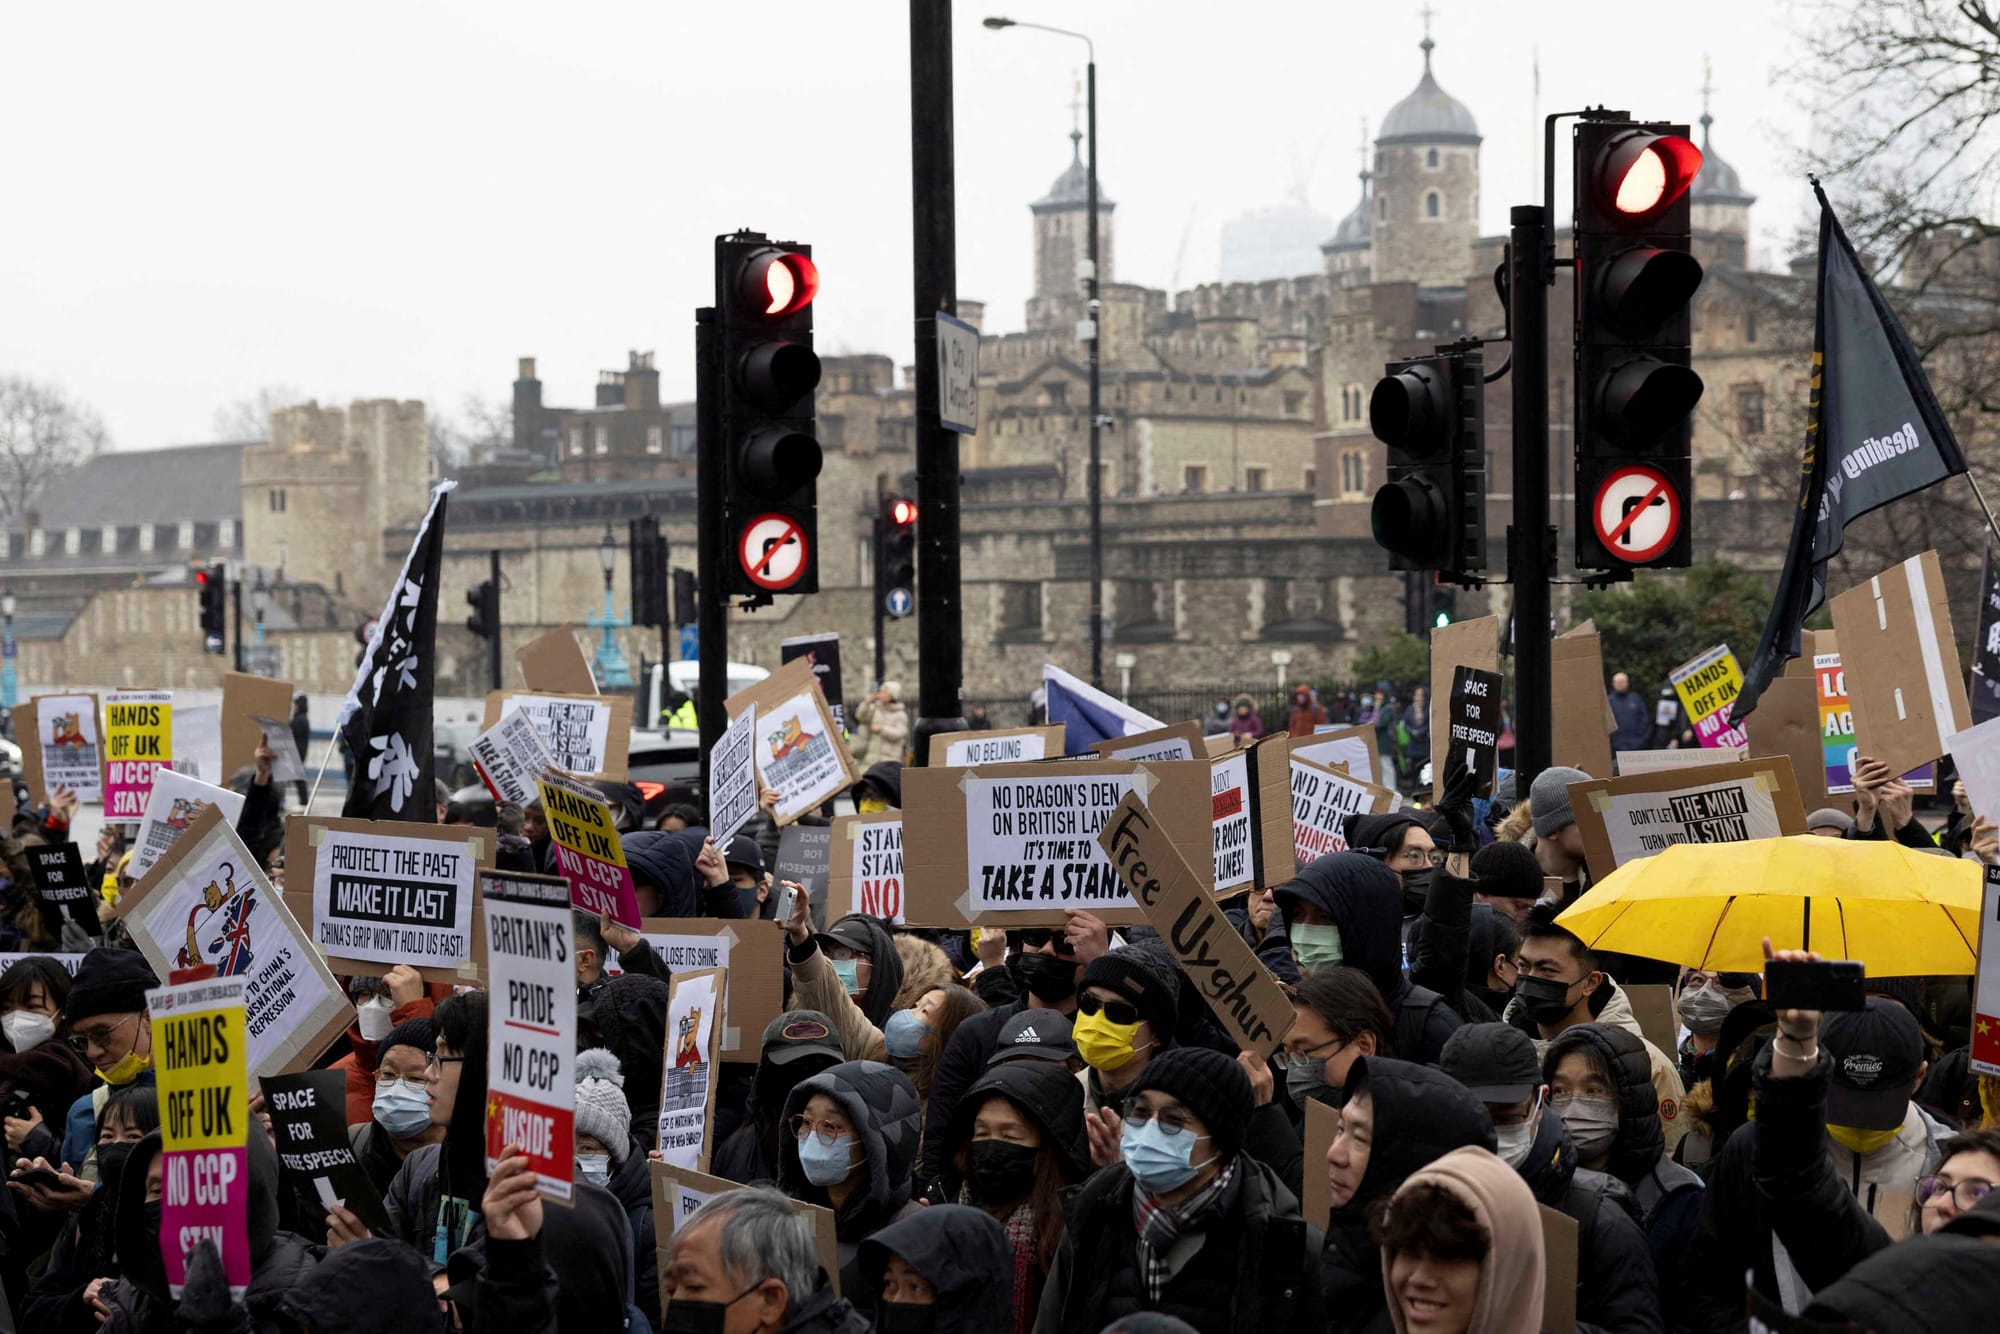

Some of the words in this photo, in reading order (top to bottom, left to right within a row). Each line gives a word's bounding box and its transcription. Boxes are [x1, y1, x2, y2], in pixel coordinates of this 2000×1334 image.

[1817, 657, 1831, 665] SAVE
[1464, 680, 1488, 697] SPACE
[1684, 660, 1728, 696] HANDS
[550, 704, 568, 719] THE
[569, 704, 593, 721] MINT
[1466, 704, 1480, 720] FOR
[1694, 691, 1716, 716] OFF
[1717, 679, 1738, 701] UK
[111, 706, 160, 727] HANDS
[550, 721, 558, 736] A
[559, 721, 586, 737] STINT
[1698, 714, 1721, 738] NO
[112, 735, 130, 756] OFF
[135, 735, 160, 756] UK
[569, 738, 591, 754] GRIP
[1452, 724, 1468, 740] FREE
[1468, 727, 1495, 747] SPEECH
[475, 736, 499, 766] TAKE
[966, 743, 981, 763] NO
[983, 740, 1021, 762] BEIJING
[110, 762, 123, 785] NO
[490, 762, 503, 773] A
[1213, 770, 1230, 794] MINT
[495, 769, 528, 803] STAND!
[992, 785, 1011, 809] NO
[1016, 783, 1087, 809] DRAGON'S
[1091, 782, 1119, 807] DEN
[1323, 780, 1362, 815] TALL
[114, 791, 149, 814] STAY
[544, 784, 604, 828] HANDS
[1629, 808, 1656, 826] DON'T
[1659, 807, 1674, 824] LET
[1672, 796, 1705, 822] THE
[1704, 788, 1744, 816] MINT
[993, 812, 1012, 836] ON
[1018, 810, 1076, 835] BRITISH
[1081, 809, 1115, 834] LAN
[1222, 817, 1248, 850] ROOTS
[1640, 833, 1666, 851] TURN
[1688, 824, 1699, 845] A
[1702, 816, 1744, 843] STINT
[552, 817, 581, 849] OFF
[585, 831, 615, 860] UK
[1024, 840, 1045, 860] IT'S
[1047, 840, 1075, 860] TIME
[1077, 839, 1091, 860] TO
[39, 852, 67, 865] SPACE
[332, 844, 390, 873] PROTECT
[394, 849, 420, 876] THE
[422, 852, 460, 879] PAST
[558, 844, 583, 876] NO
[586, 857, 623, 890] CCP
[1218, 849, 1244, 882] LINES!
[47, 871, 64, 883] FOR
[982, 864, 1036, 902] TAKE
[1039, 864, 1055, 900] A
[55, 886, 89, 901] SPEECH
[337, 881, 382, 915] MAKE
[384, 885, 402, 916] IT
[403, 887, 448, 921] LAST
[579, 881, 620, 919] STAY
[861, 878, 900, 918] NO
[491, 913, 567, 963] BRITAIN'S
[1111, 805, 1161, 907] Free
[1170, 896, 1272, 1043] Uyghur
[320, 922, 351, 947] CHINA'S
[353, 925, 371, 949] GRIP
[373, 927, 400, 952] WON'T
[400, 930, 424, 954] HOLD
[426, 932, 438, 955] US
[439, 933, 464, 957] FAST!
[247, 981, 260, 996] TO
[259, 947, 292, 985] CHINA'S
[665, 946, 684, 966] LOSE
[685, 947, 696, 966] ITS
[697, 948, 718, 967] SHINE
[208, 983, 243, 1001] EMBASSY
[245, 968, 296, 1026] ANSNATIONAL
[509, 979, 555, 1026] PRIDE
[249, 987, 296, 1038] REPRESSION
[164, 1013, 229, 1070] HANDS
[503, 1041, 523, 1084] NO
[528, 1048, 560, 1092] CCP
[1843, 1058, 1883, 1073] Premier
[168, 1089, 194, 1140] OFF
[200, 1086, 232, 1137] UK
[272, 1088, 316, 1111] SPACE
[289, 1122, 315, 1141] FOR
[503, 1105, 554, 1160] INSIDE
[660, 1117, 669, 1130] CCP
[281, 1153, 306, 1171] FREE
[305, 1148, 356, 1171] SPEECH
[167, 1155, 189, 1207] NO
[193, 1152, 237, 1207] CCP
